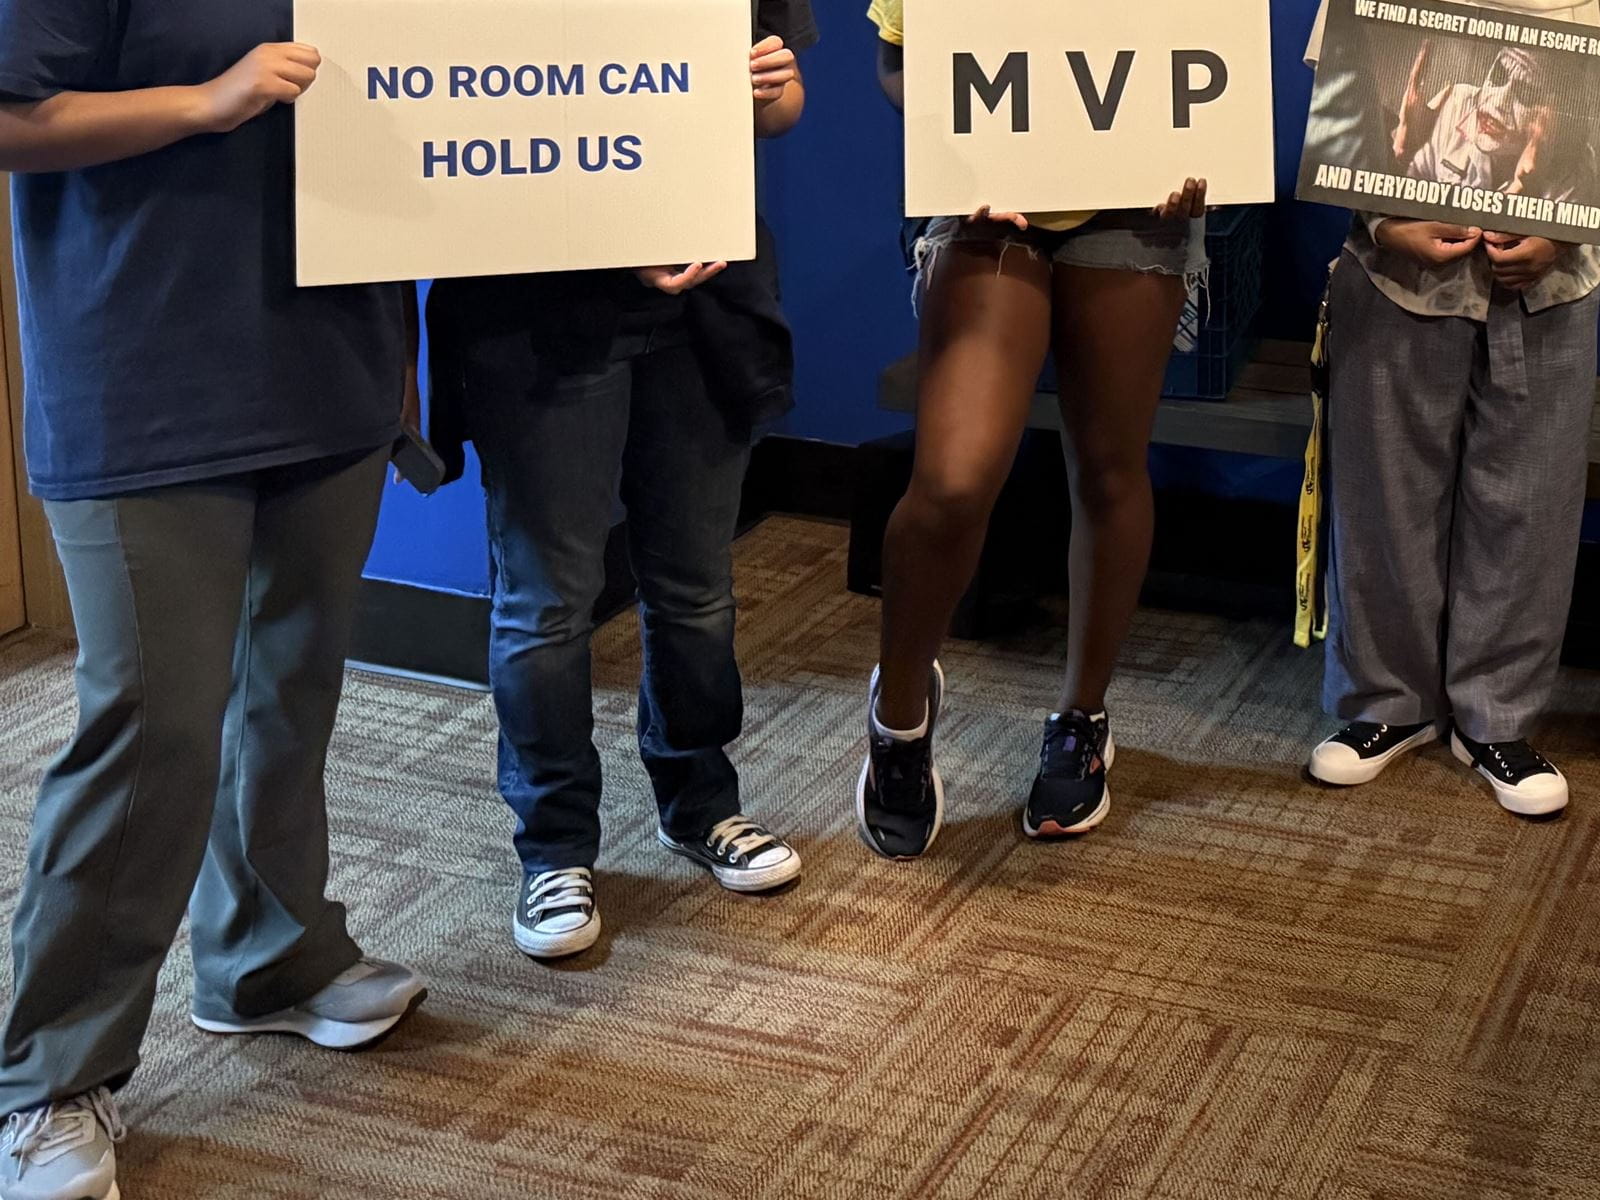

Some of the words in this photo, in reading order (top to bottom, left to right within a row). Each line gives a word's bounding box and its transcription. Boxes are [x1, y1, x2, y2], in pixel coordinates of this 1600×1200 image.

[1377, 2, 1406, 24] FIND
[1407, 8, 1418, 25] A
[1419, 9, 1469, 33] SECRET
[1468, 17, 1503, 39] DOOR
[1505, 25, 1519, 41] IN
[1520, 28, 1539, 46] AN
[1540, 30, 1587, 54] ESCAPE
[366, 66, 433, 100] NO
[449, 64, 584, 98] ROOM
[599, 62, 689, 95] CAN
[952, 50, 1228, 134] MVP
[422, 137, 561, 178] HOLD
[577, 135, 643, 172] US
[1314, 164, 1352, 191] AND
[1353, 170, 1452, 206] EVERYBODY
[1452, 186, 1504, 215] LOSES
[1504, 194, 1555, 223] THEIR
